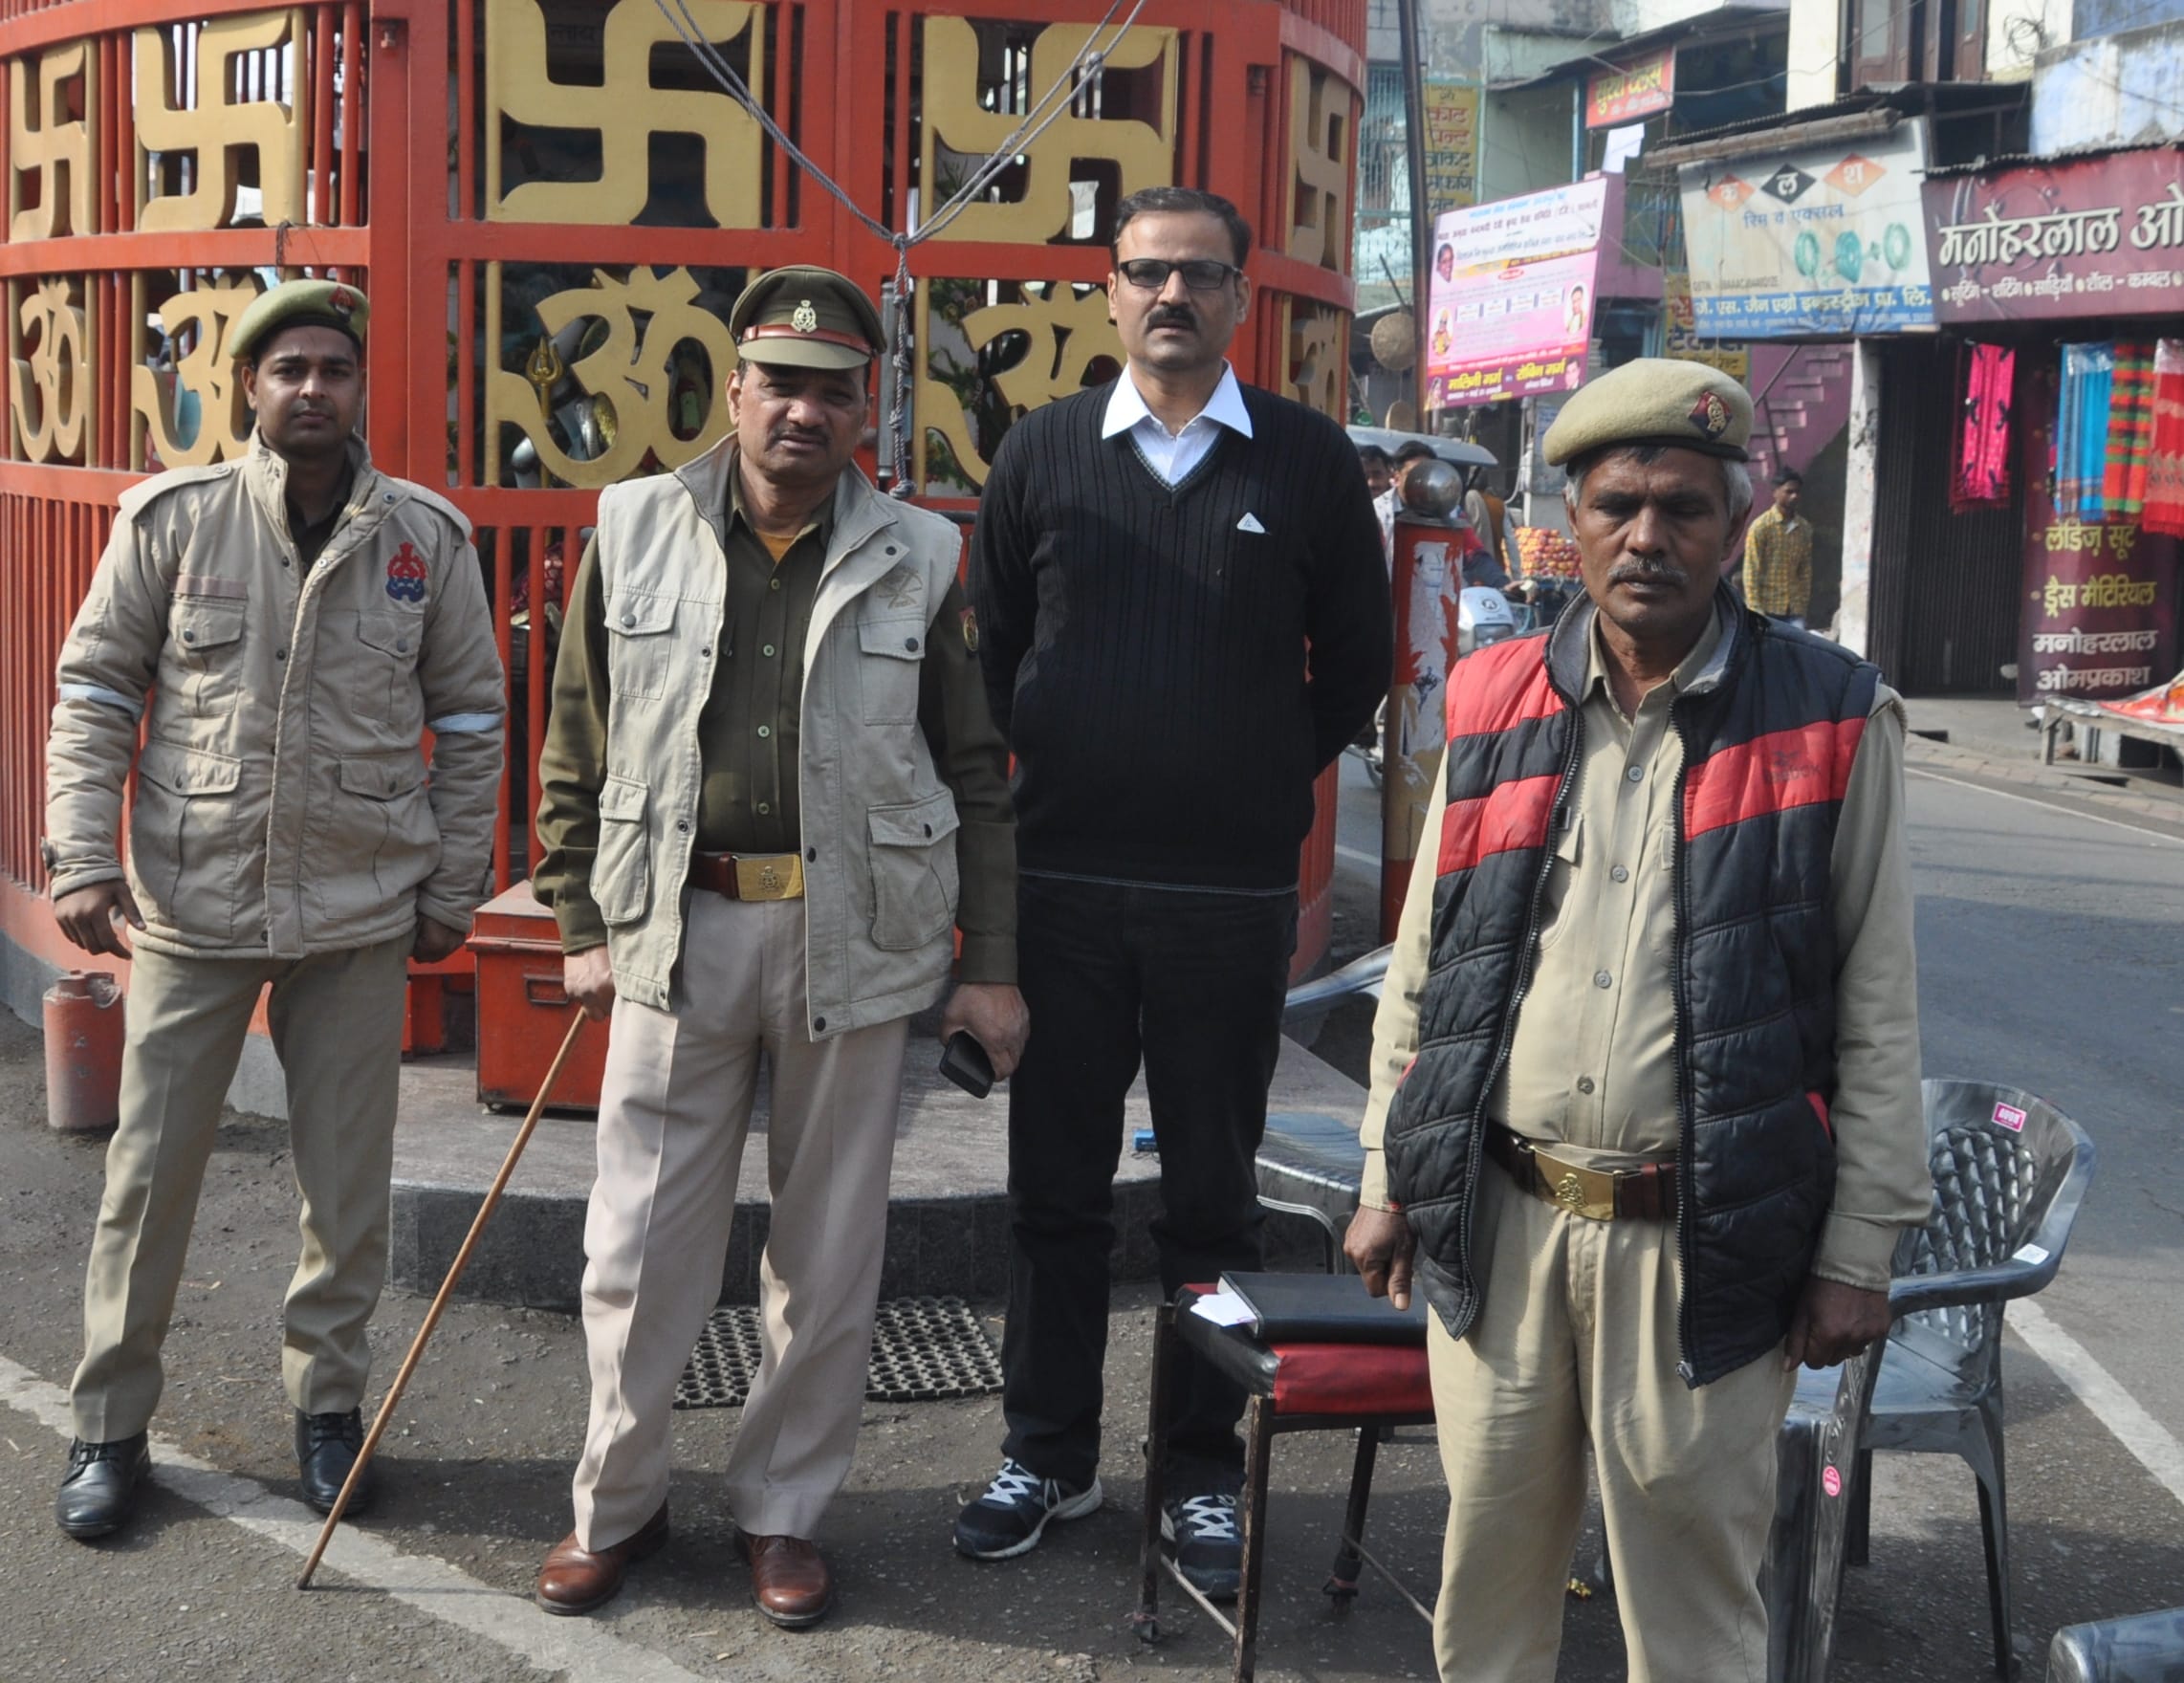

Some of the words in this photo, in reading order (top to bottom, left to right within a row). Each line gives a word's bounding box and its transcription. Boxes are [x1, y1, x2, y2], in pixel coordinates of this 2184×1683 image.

[1938, 204, 2122, 267] मनोहरलाल
[2033, 626, 2159, 655] मनोहरलाल
[2036, 663, 2151, 691] ओमप्रकाश
